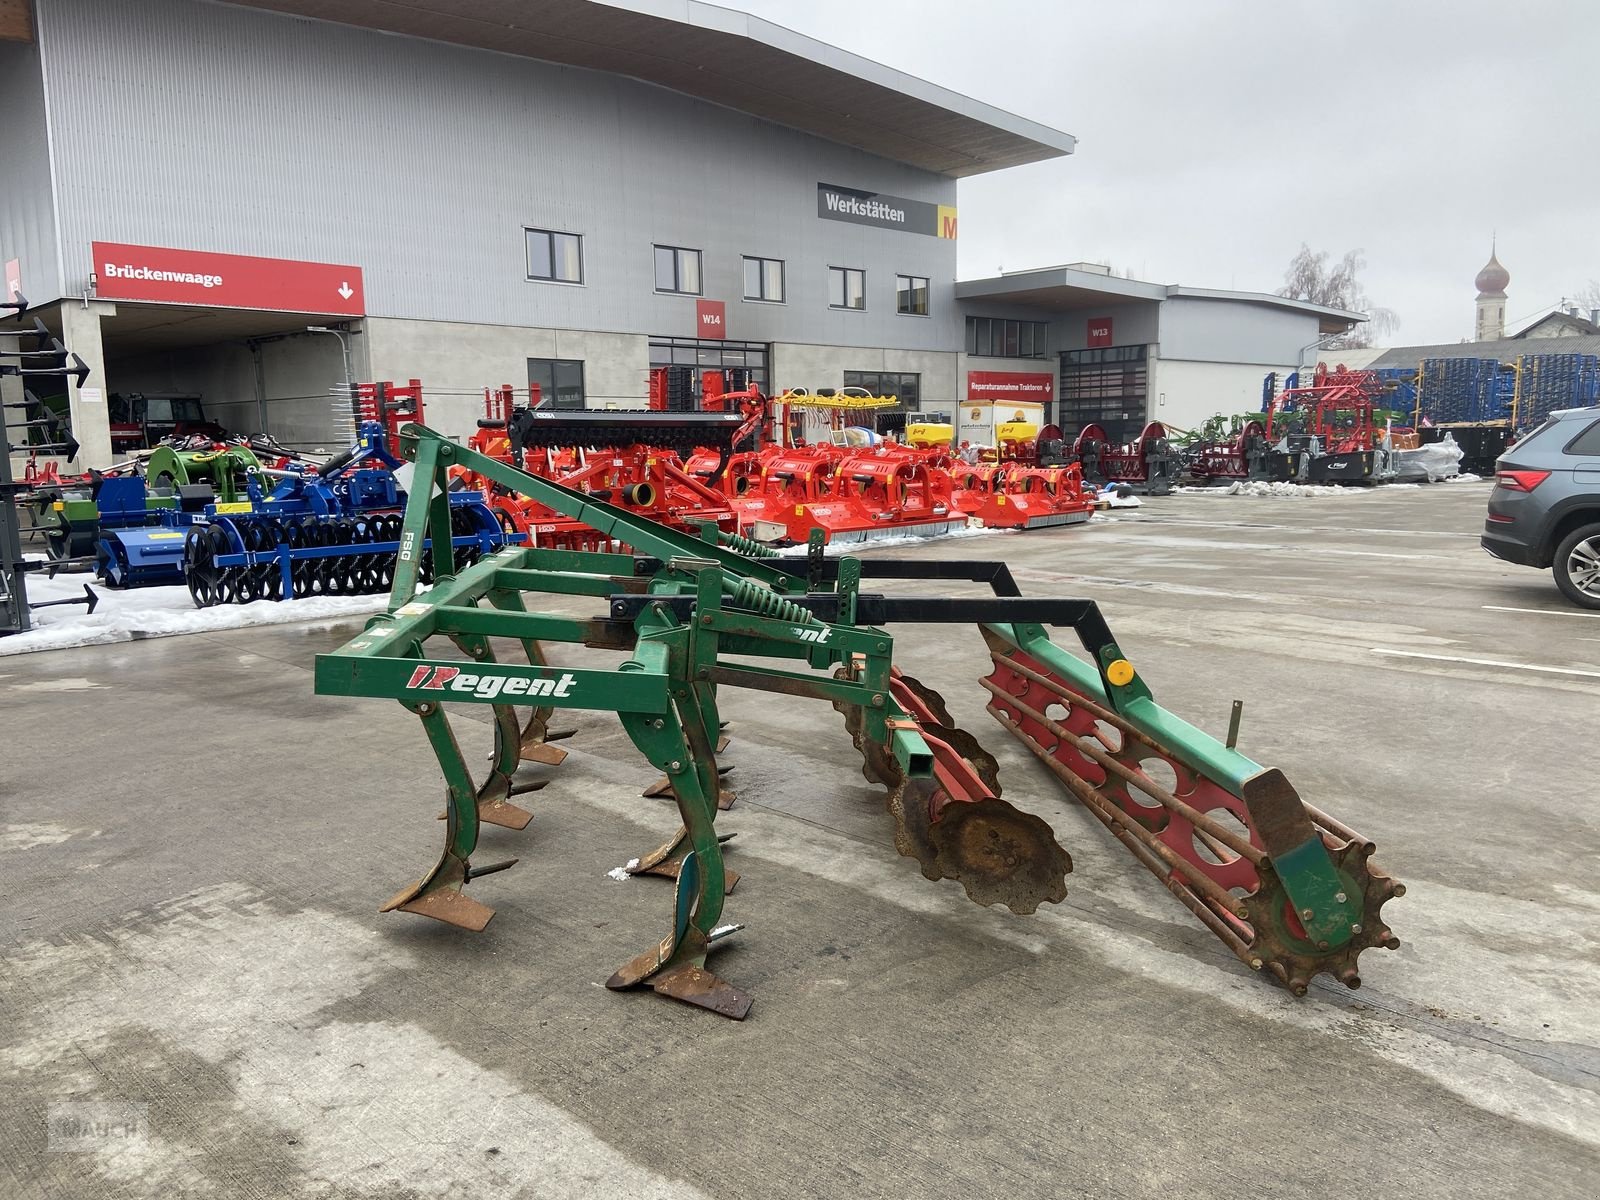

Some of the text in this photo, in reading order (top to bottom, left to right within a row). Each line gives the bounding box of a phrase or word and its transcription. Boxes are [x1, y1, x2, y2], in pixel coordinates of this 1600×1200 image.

[825, 192, 905, 223] Werkstätten
[104, 263, 223, 287] Brückenwaage
[702, 314, 721, 325] W14
[1092, 328, 1108, 337] W13
[971, 382, 1043, 392] Reparaturannahme Traktoren
[405, 665, 578, 698] Regent
